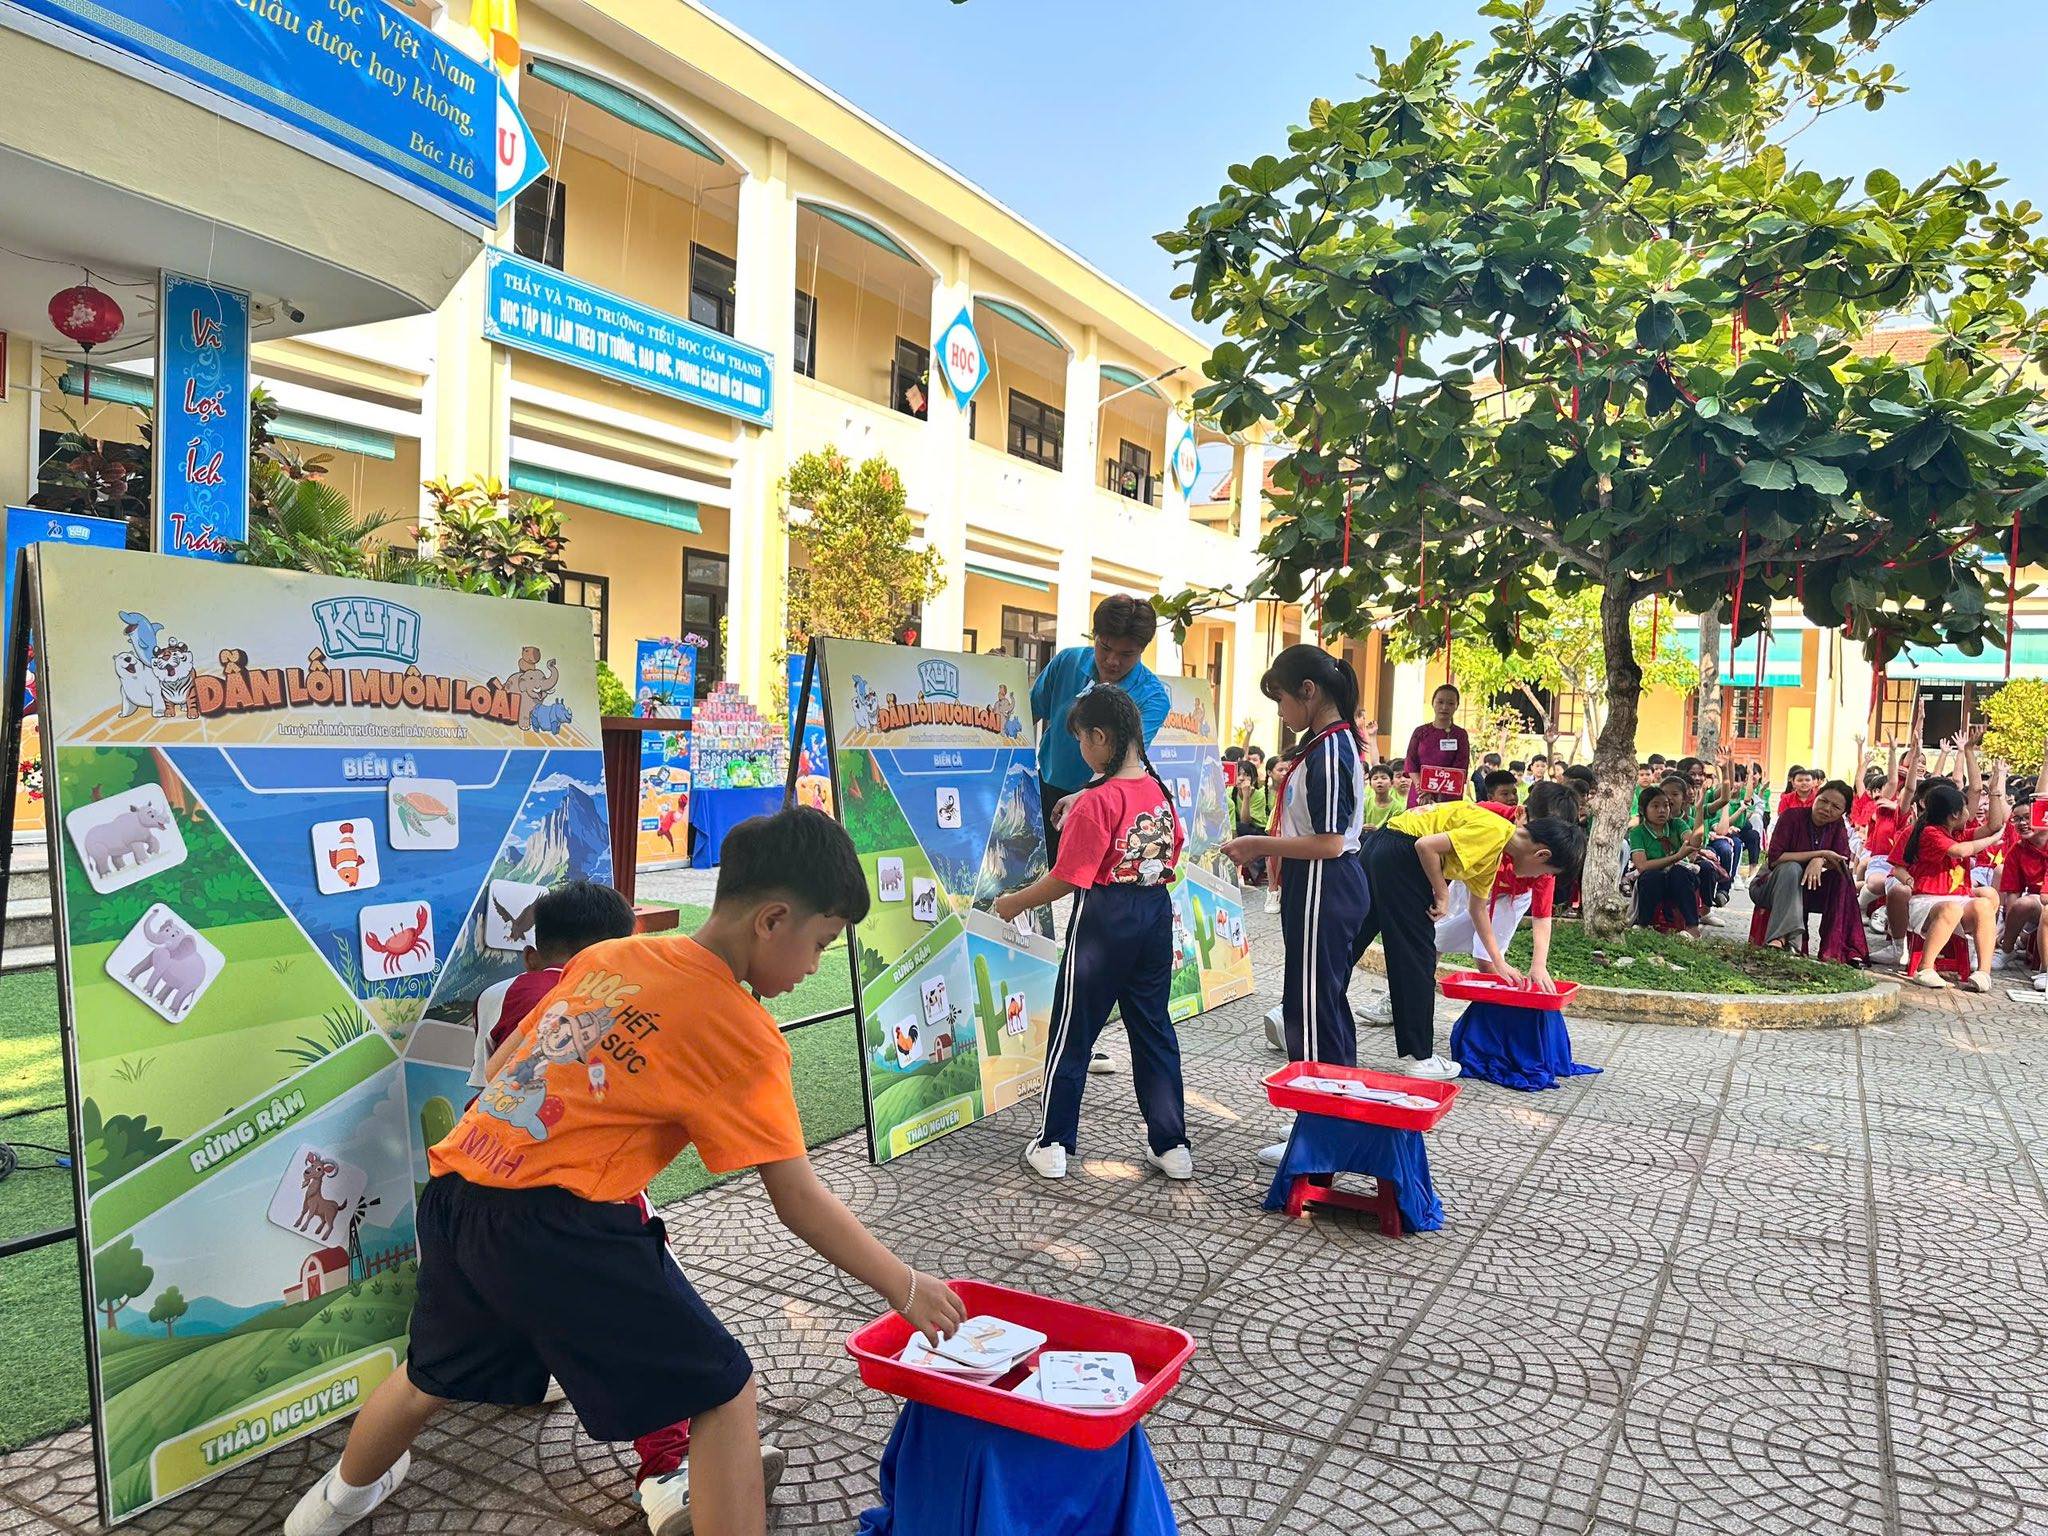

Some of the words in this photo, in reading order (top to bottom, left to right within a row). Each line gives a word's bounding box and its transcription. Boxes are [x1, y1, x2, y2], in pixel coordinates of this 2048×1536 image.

[378, 13, 421, 59] Việt
[431, 48, 476, 95] Nam
[307, 19, 363, 68] được
[368, 51, 407, 96] hay
[412, 77, 474, 137] không,
[410, 131, 444, 163] Bác
[449, 152, 474, 180] Hồ
[191, 308, 222, 349] Vì
[500, 298, 520, 330] HỌC
[522, 302, 539, 337] TẬP
[540, 309, 552, 338] VÀ
[554, 313, 574, 345] LÀM
[575, 322, 595, 352] THEO
[545, 287, 562, 305] VÀ
[566, 294, 592, 316] TRÒ
[594, 305, 645, 336] TRƯỜNG
[677, 336, 701, 355] HỌC
[727, 354, 762, 378] THANH
[951, 343, 975, 376] HỌC
[184, 377, 226, 424] Lợi
[186, 437, 224, 485] Ích
[200, 649, 287, 718] DẪN
[349, 665, 450, 711] MUÔN
[452, 678, 521, 725] LOÀI
[432, 727, 451, 738] CON
[879, 693, 911, 732] DẪN
[933, 699, 973, 726] MUÔN
[973, 704, 1001, 734] LOÀI
[343, 752, 389, 780] BIỂN
[1428, 777, 1455, 792] 5/4
[1434, 769, 1450, 779] Lớp
[573, 969, 644, 1008] HỌC
[616, 1004, 662, 1040] HẾT
[601, 1033, 647, 1075] SỨC
[189, 1120, 258, 1174] RỪNG
[255, 1089, 307, 1130] RẬM
[906, 1122, 929, 1145] THẢO
[929, 1109, 960, 1135] NGUYÊN
[201, 1418, 270, 1467] THẢO
[271, 1376, 360, 1434] NGUYÊN
